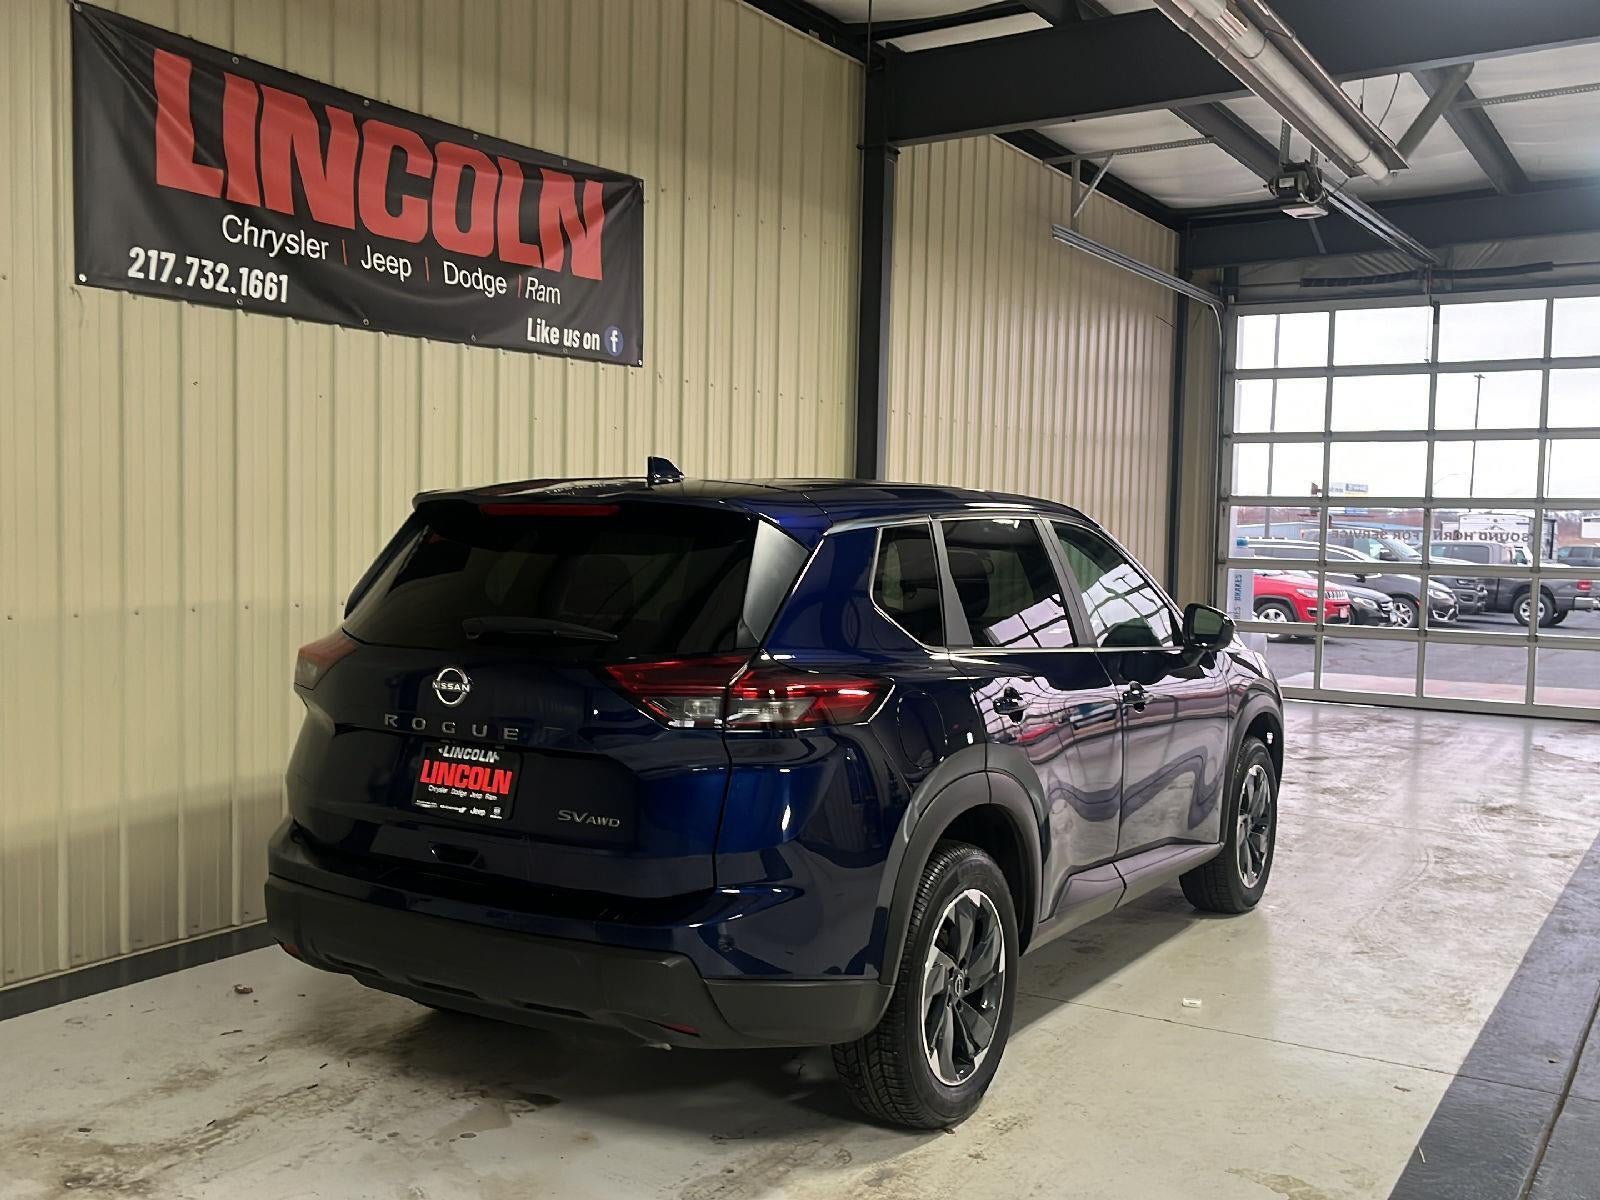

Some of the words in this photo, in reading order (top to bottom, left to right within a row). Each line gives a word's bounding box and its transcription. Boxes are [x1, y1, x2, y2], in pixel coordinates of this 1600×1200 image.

[154, 48, 604, 280] LINCOLN
[128, 246, 289, 303] 217.732.1661
[221, 214, 329, 261] Chrysler
[360, 244, 412, 282] Jeep
[442, 261, 508, 298] Dodge
[525, 277, 562, 305] Ram
[526, 317, 560, 346] Like
[563, 328, 580, 348] us
[583, 331, 601, 351] on
[432, 681, 470, 692] NISSAN
[384, 713, 519, 741] ROGUE
[442, 745, 495, 763] LINCOLN
[420, 759, 513, 795] LINCOLN
